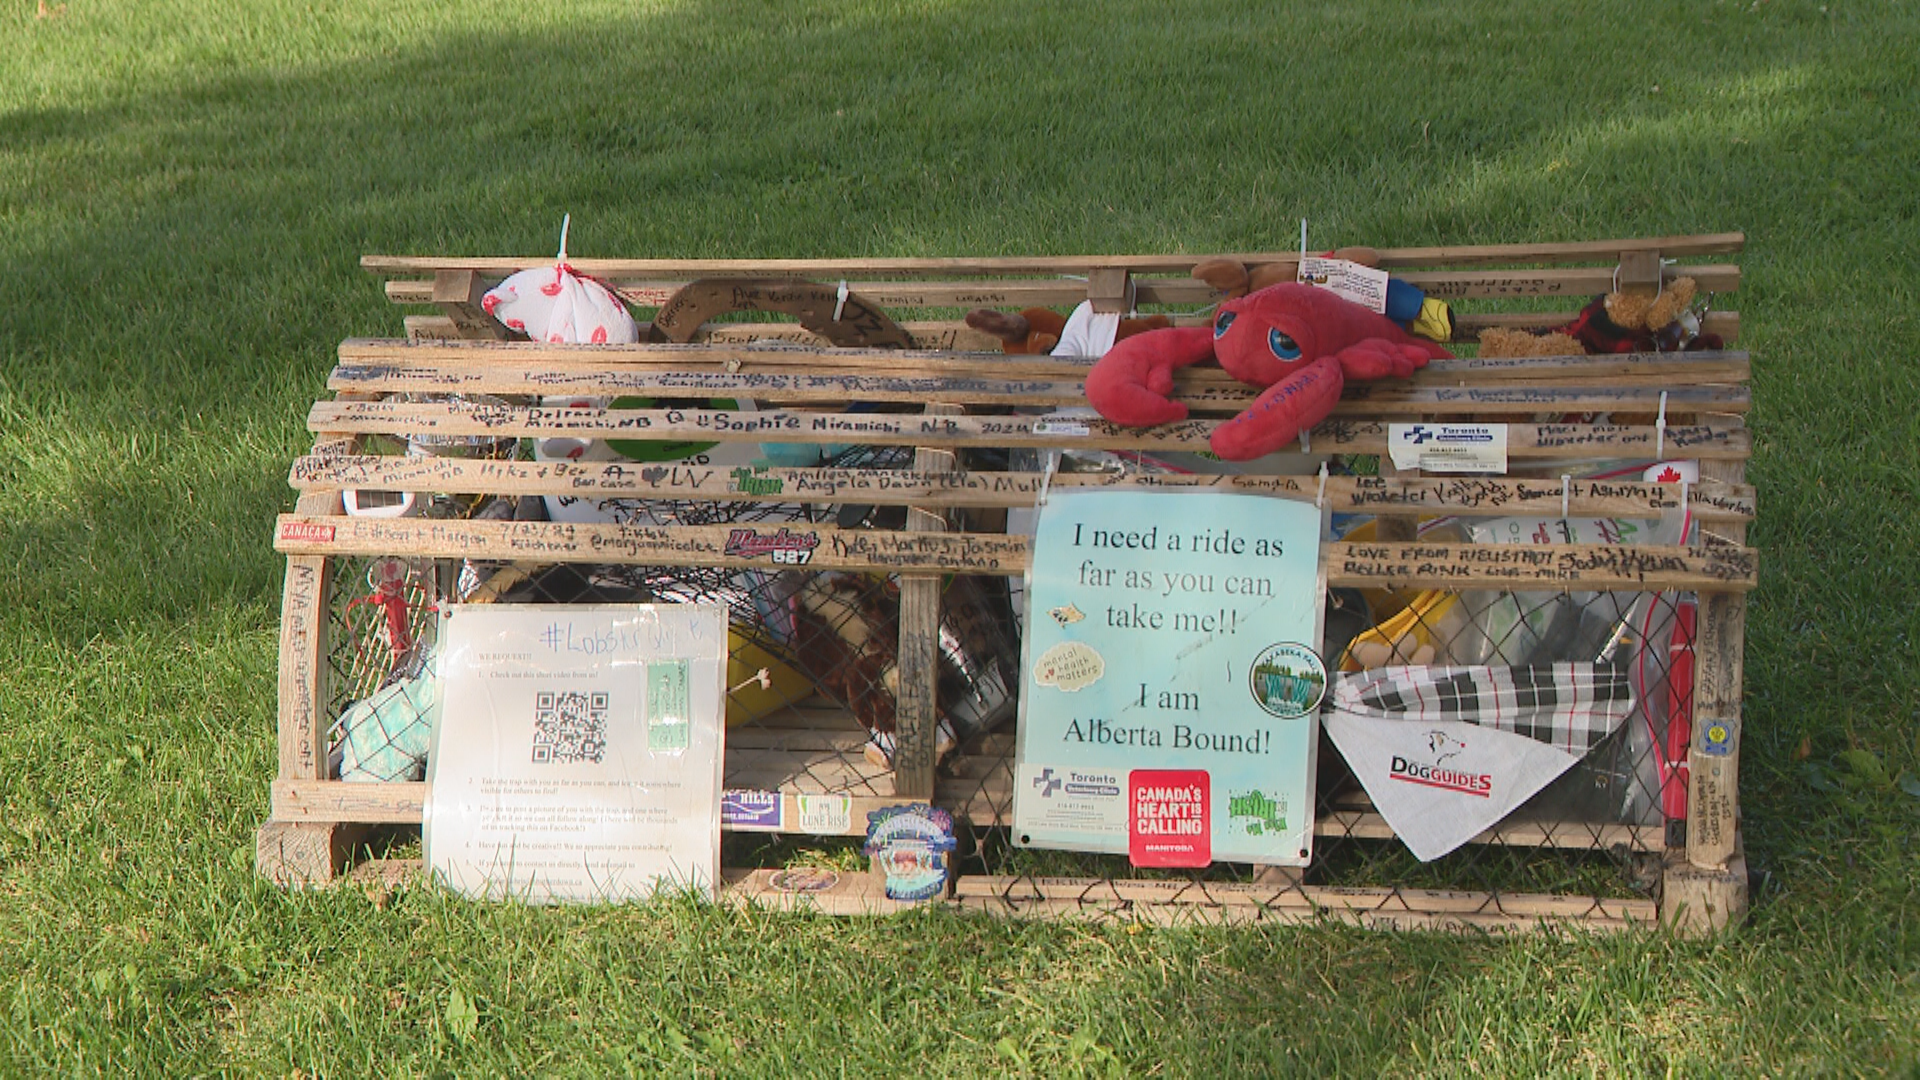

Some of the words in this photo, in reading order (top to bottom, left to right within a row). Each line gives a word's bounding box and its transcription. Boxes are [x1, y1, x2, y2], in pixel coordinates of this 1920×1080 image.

[1072, 523, 1084, 546] I
[1092, 526, 1157, 550] need
[1166, 533, 1182, 551] a
[1191, 528, 1245, 555] ride
[1254, 538, 1284, 557] as
[1078, 559, 1116, 587] far
[1124, 569, 1153, 589] as
[1161, 571, 1216, 597] you
[1224, 577, 1273, 597] can
[1106, 603, 1164, 630] take
[1174, 609, 1238, 635] me!!
[1043, 647, 1077, 668] mental
[1057, 656, 1090, 672] health
[1056, 665, 1098, 681] matters
[1137, 683, 1147, 708] I
[1157, 688, 1200, 711] am
[1063, 718, 1162, 748] Alberta
[1172, 724, 1271, 755] Bound!
[1070, 772, 1117, 784] Toronto
[1136, 783, 1202, 803] CANADA'S
[1136, 802, 1190, 819] HEART
[1190, 802, 1202, 815] IS
[1136, 818, 1202, 836] CALLING
[1145, 844, 1194, 853] MANITOBA
